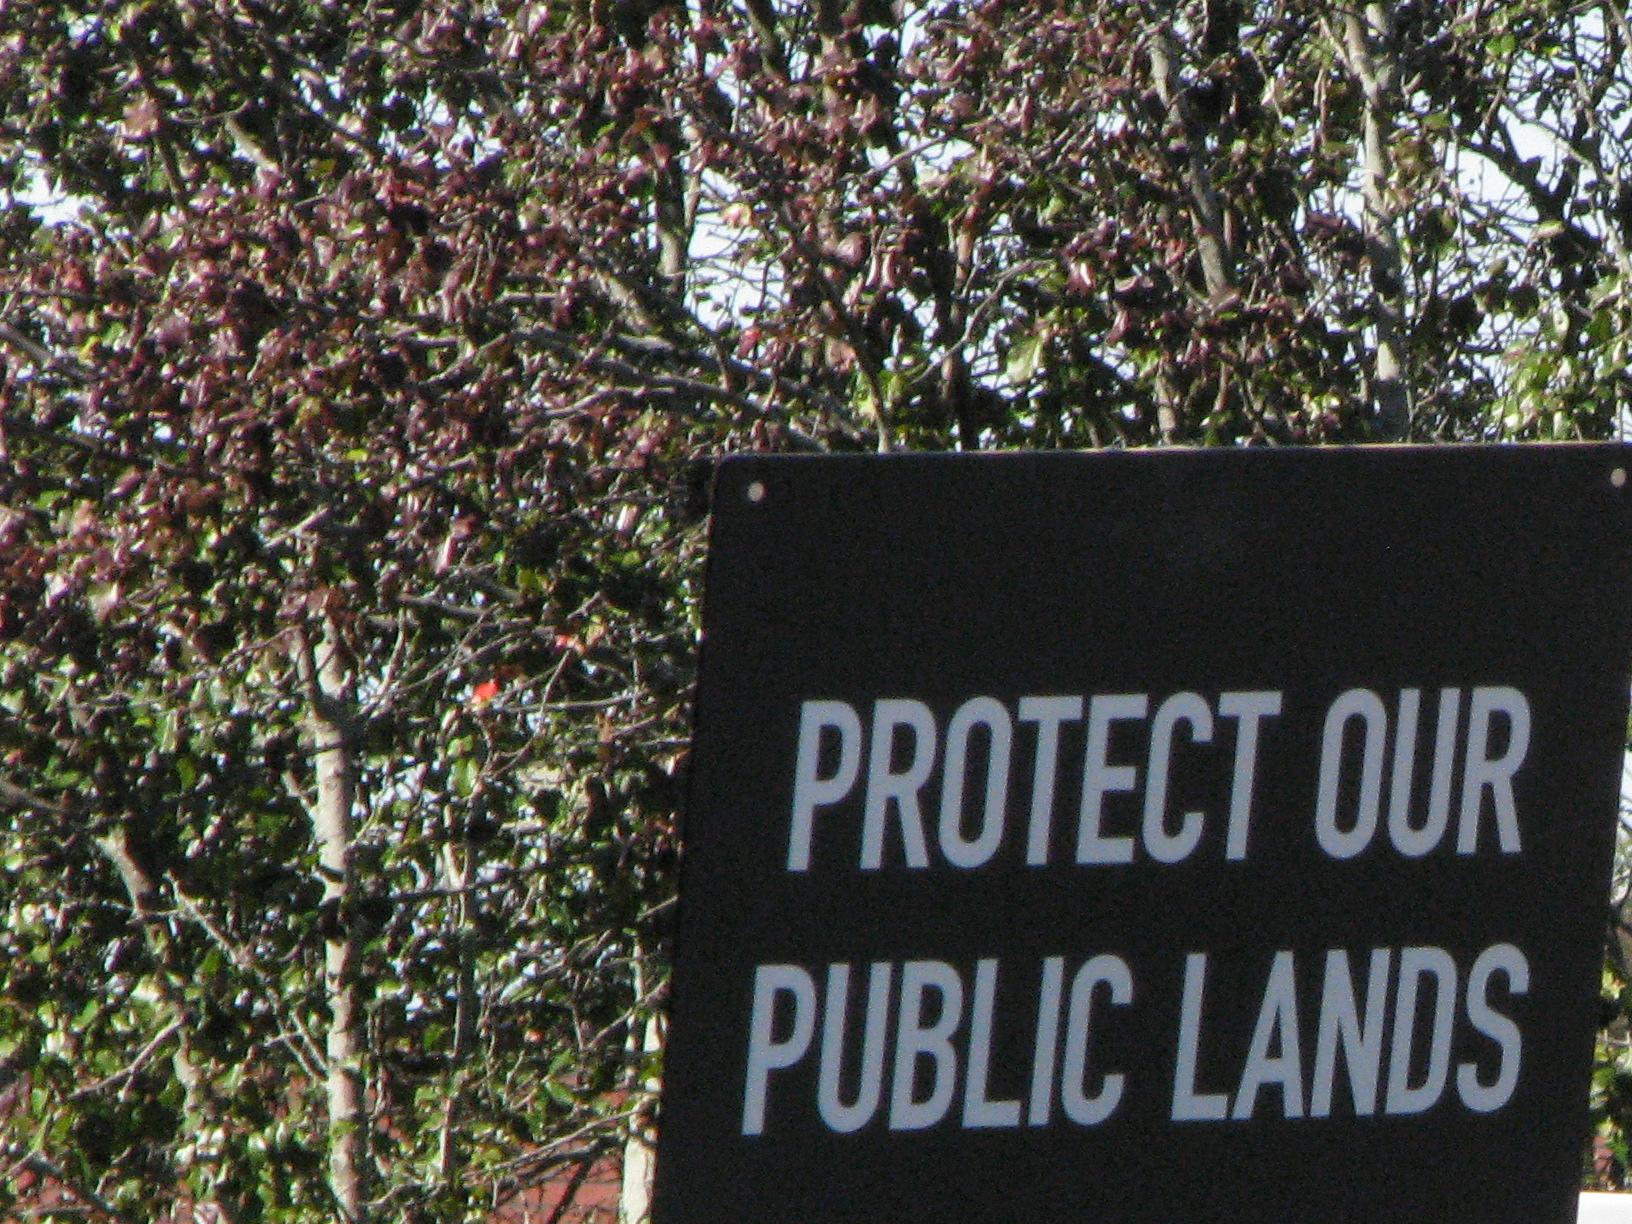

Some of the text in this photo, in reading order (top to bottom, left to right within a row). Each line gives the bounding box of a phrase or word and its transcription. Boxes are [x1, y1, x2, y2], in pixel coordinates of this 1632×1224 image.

[788, 686, 1531, 871] PROTECT OUR
[743, 943, 1529, 1135] PUBLIC LANDS
